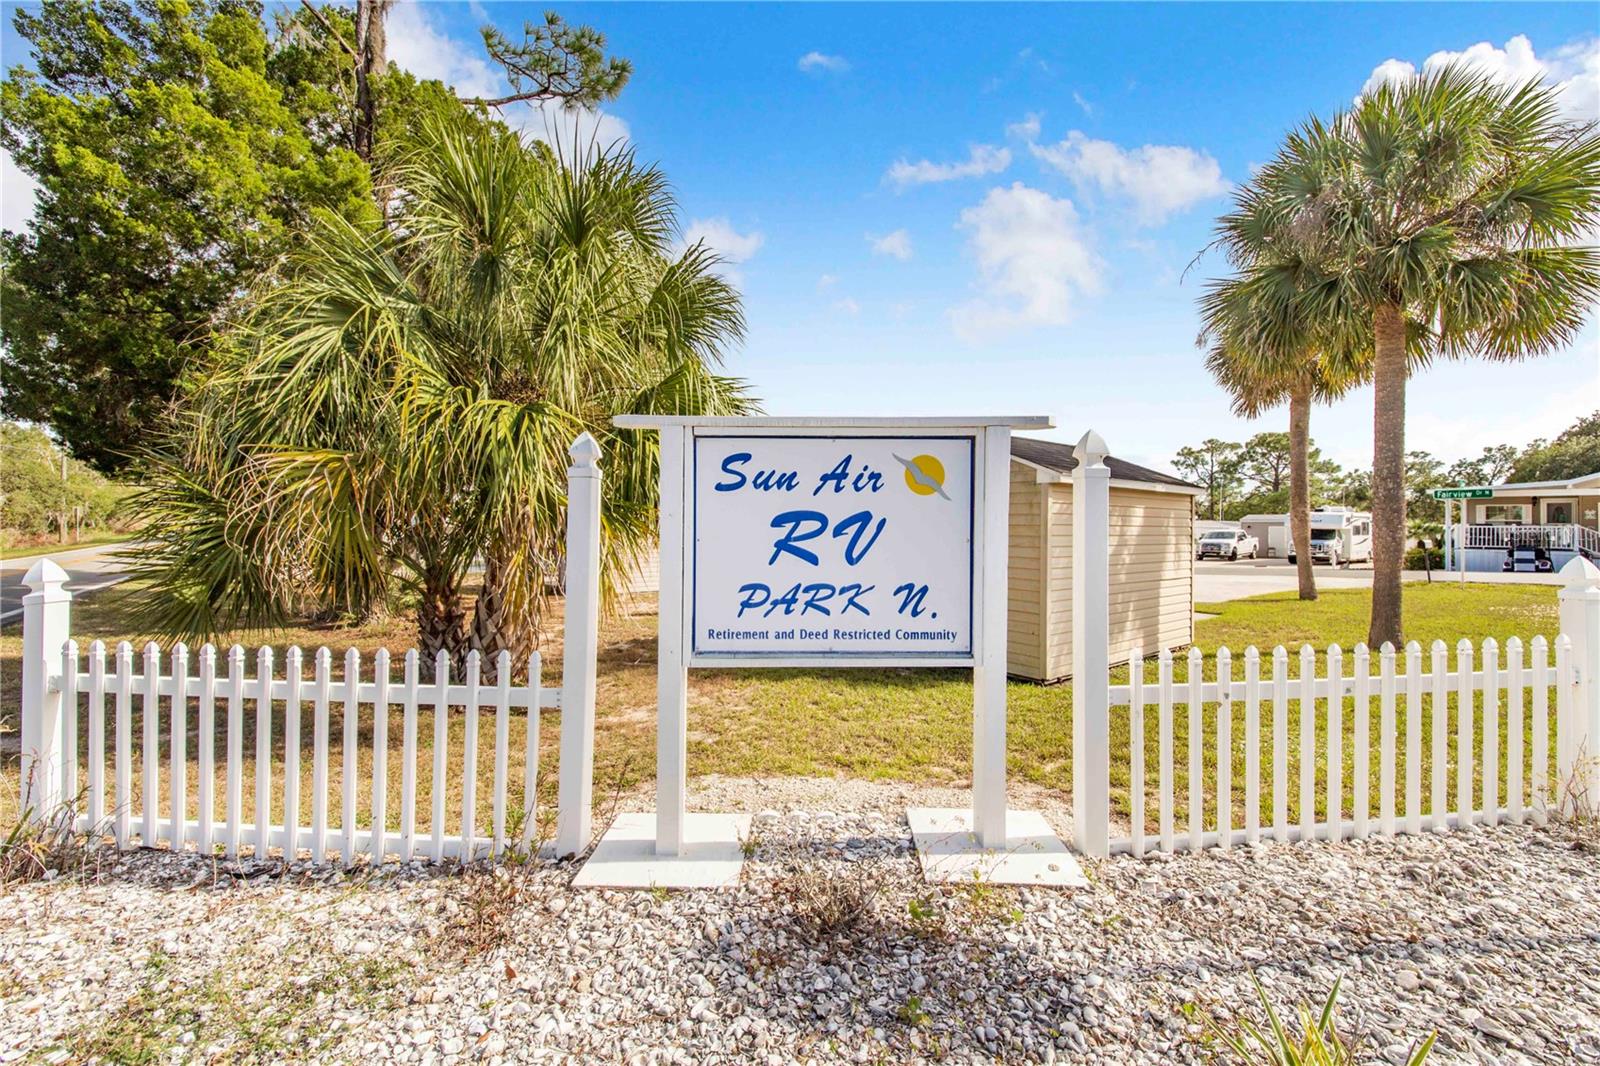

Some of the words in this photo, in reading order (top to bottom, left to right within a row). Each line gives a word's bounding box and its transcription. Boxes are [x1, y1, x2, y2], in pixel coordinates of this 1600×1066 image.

[714, 452, 799, 492] Sun
[813, 454, 884, 496] Air
[768, 510, 887, 566] RV
[737, 582, 875, 618] PARK
[892, 582, 938, 619] N.
[708, 629, 769, 640] Retirement
[775, 629, 795, 640] and
[800, 629, 829, 640] Deed
[833, 629, 891, 640] Restricted
[895, 629, 957, 642] Community
